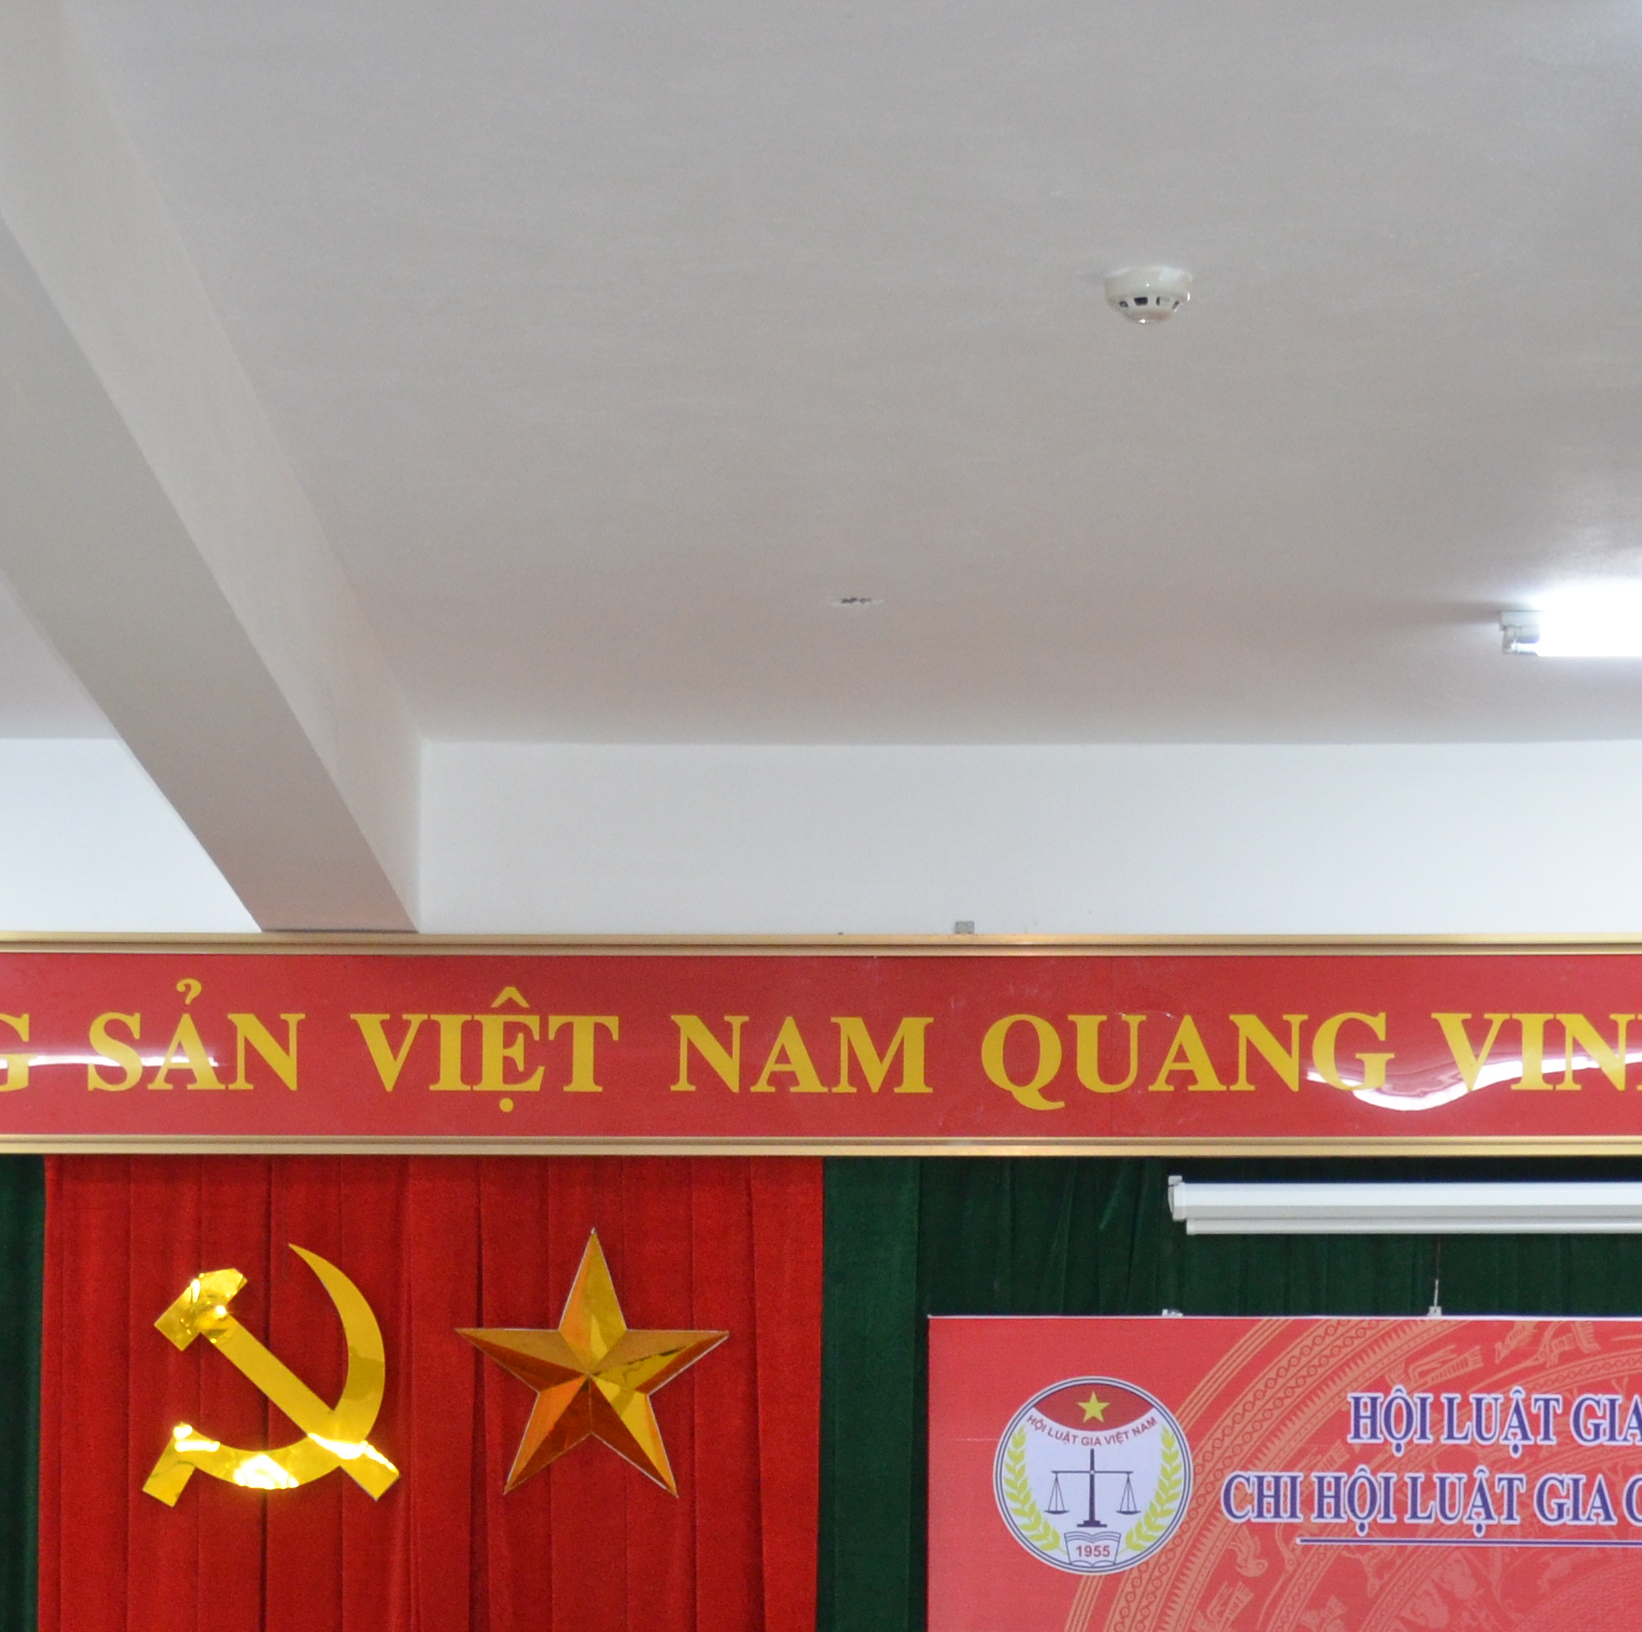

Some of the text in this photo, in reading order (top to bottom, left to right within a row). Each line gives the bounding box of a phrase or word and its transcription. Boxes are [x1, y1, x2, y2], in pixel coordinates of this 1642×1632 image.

[86, 978, 305, 1091] SẢN
[353, 986, 620, 1112] VIỆT
[671, 1014, 934, 1093] NAM
[981, 1011, 1395, 1100] QUANG
[1026, 1414, 1158, 1447] HỘI LUẬT GIA VIỆT NAM
[1348, 1385, 1434, 1456] HỘI
[1440, 1387, 1560, 1458] LUẬT
[1222, 1471, 1304, 1524] CHI
[1311, 1464, 1397, 1536] HỘI
[1404, 1465, 1526, 1537] LUẬT
[1534, 1473, 1617, 1525] GIA
[1076, 1545, 1111, 1558] 1955
